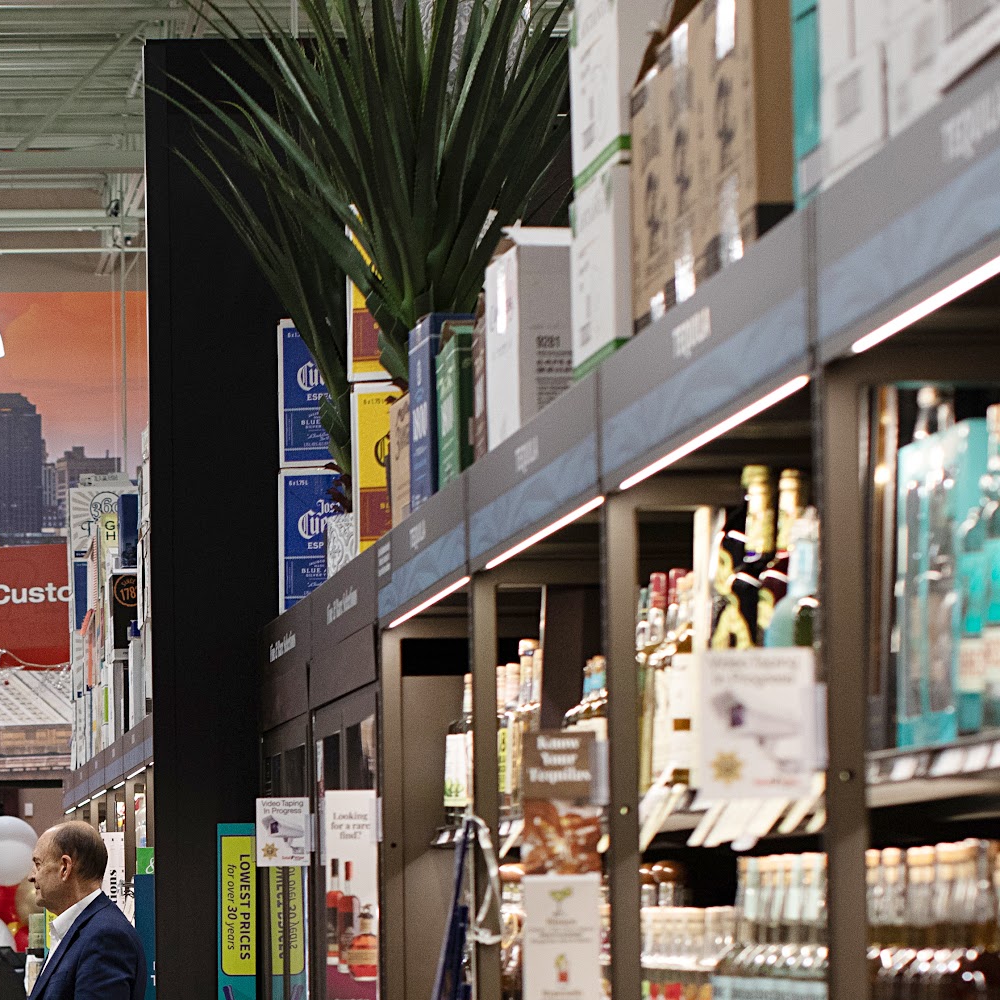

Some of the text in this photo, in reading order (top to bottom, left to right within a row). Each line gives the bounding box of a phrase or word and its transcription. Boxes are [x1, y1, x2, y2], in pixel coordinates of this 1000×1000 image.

[282, 800, 304, 809] Taping
[332, 812, 368, 821] Looking
[225, 863, 238, 950] for over 30 years
[239, 853, 251, 961] LOWEST PRICES
